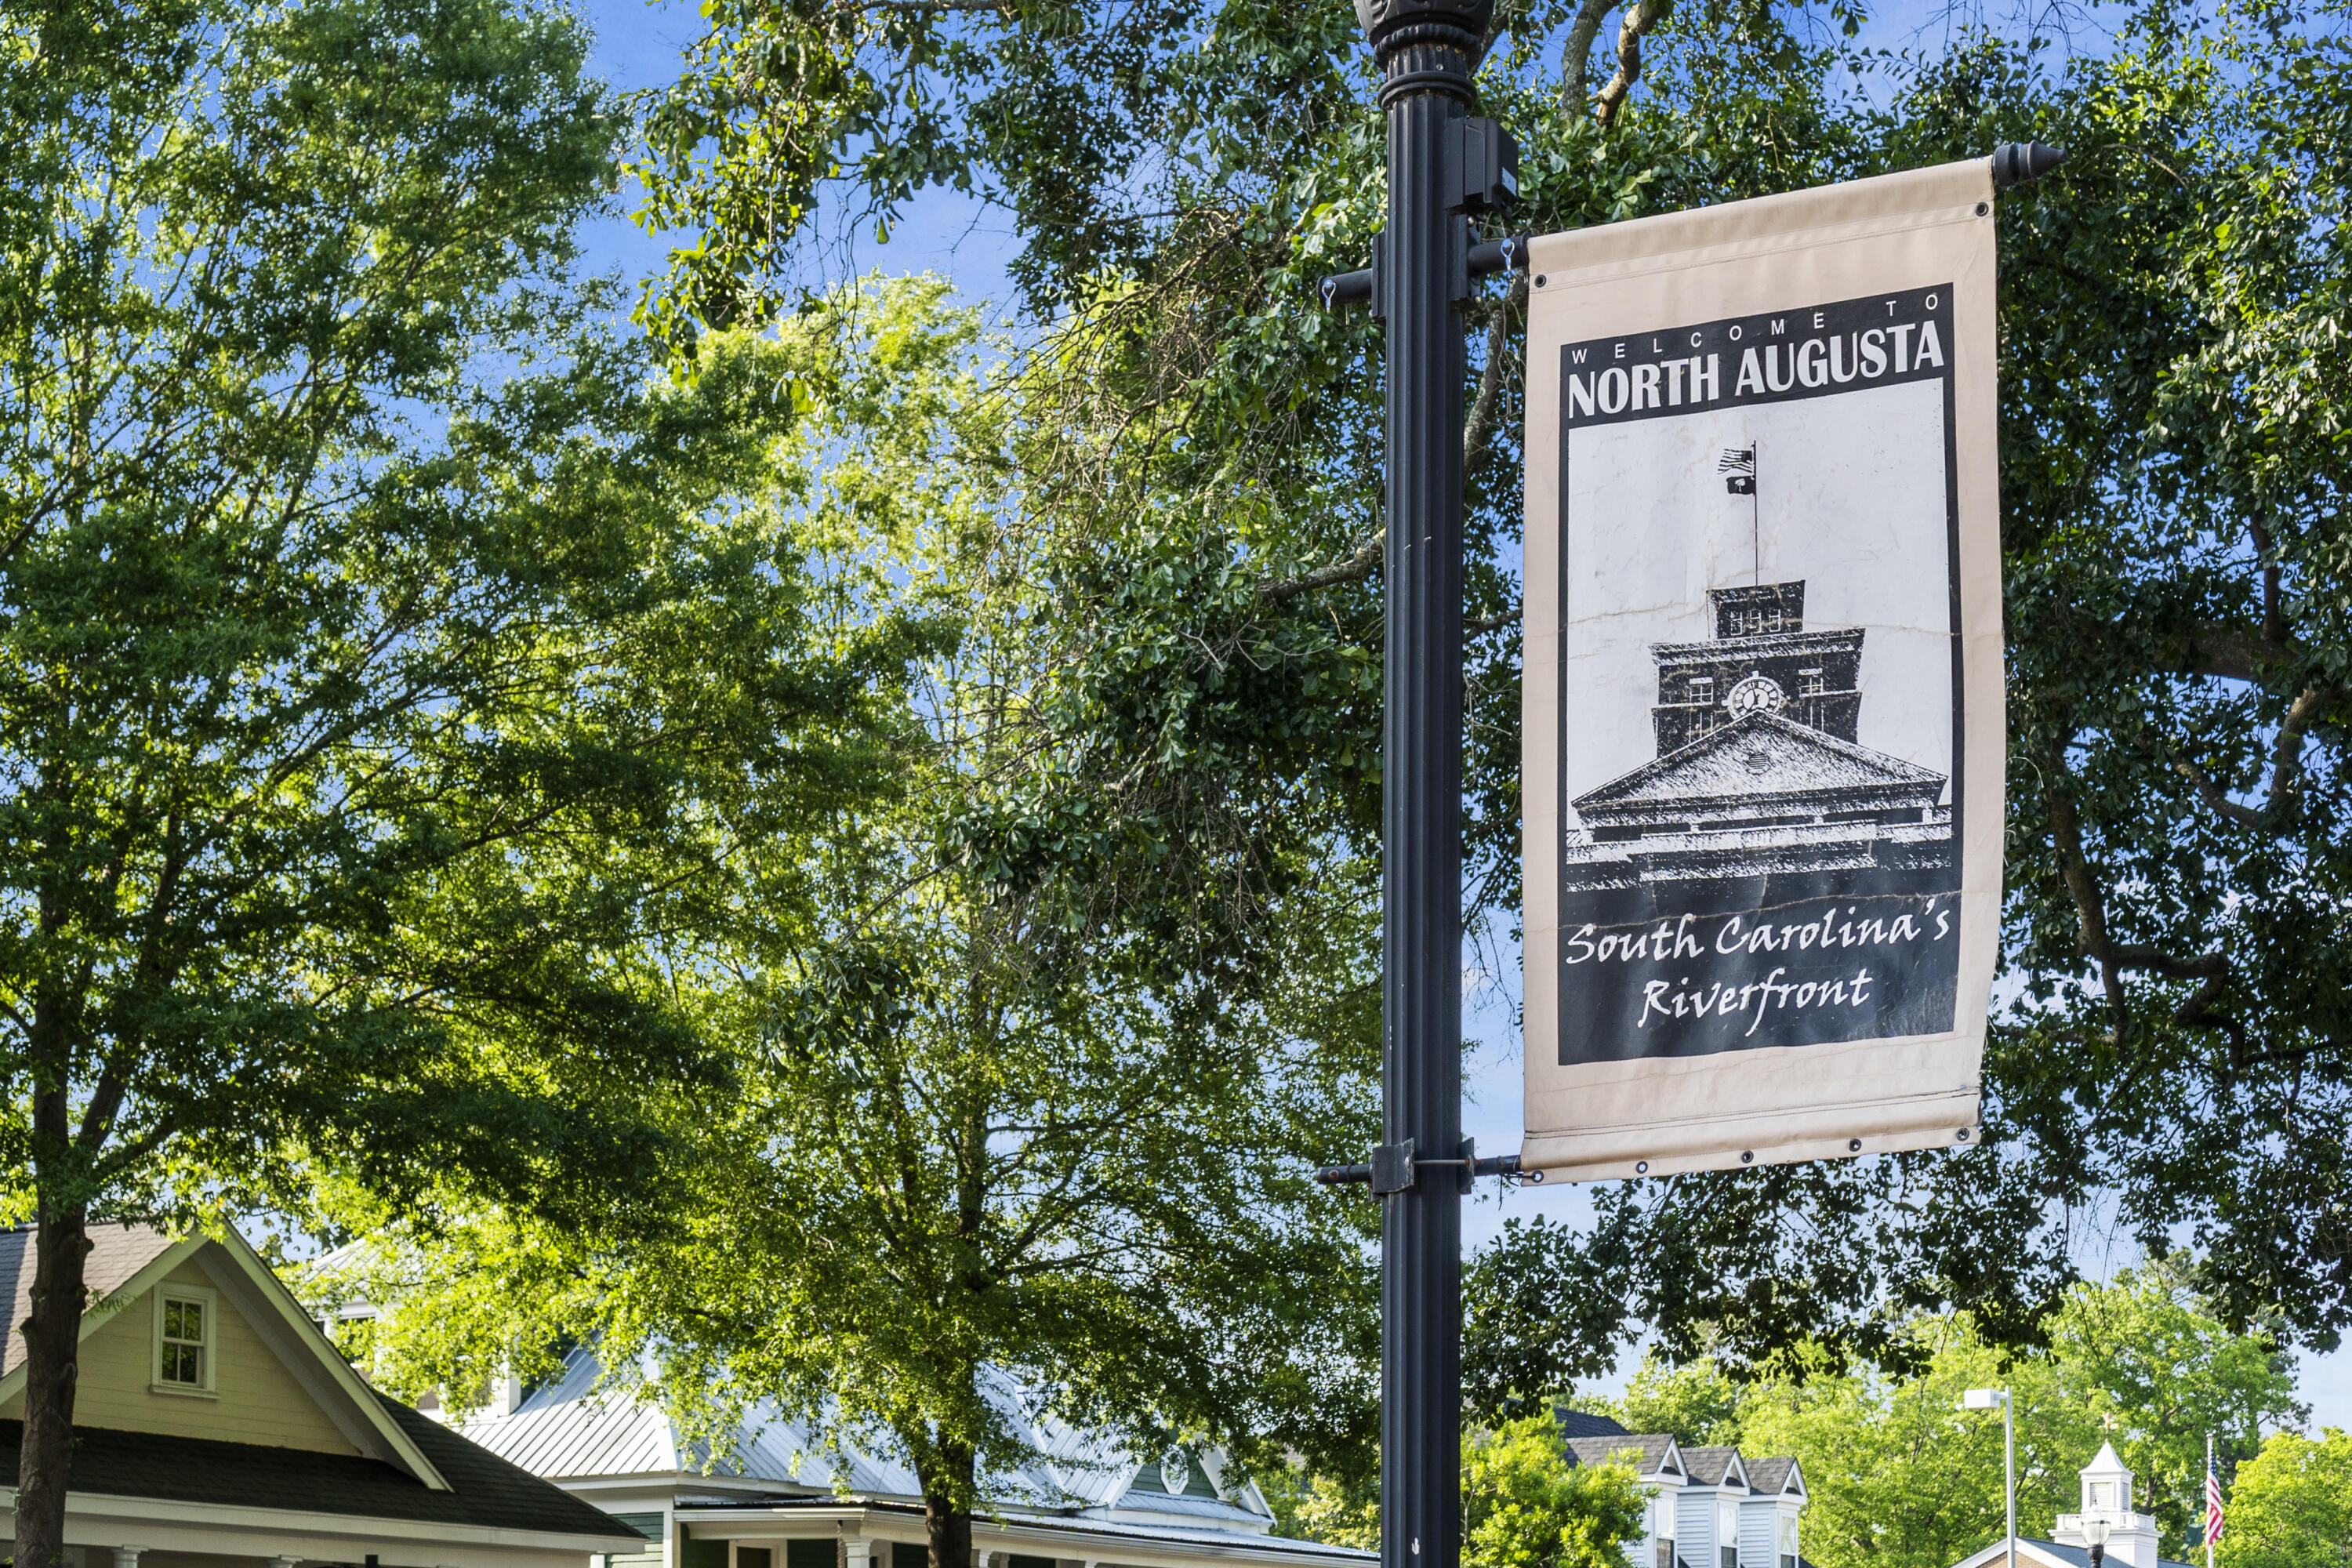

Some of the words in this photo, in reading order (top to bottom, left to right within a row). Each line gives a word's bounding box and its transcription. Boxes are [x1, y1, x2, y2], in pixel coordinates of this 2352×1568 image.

[1571, 312, 1825, 364] WELCOME
[1885, 294, 1940, 316] TO
[1568, 353, 1719, 419] NORTH
[1734, 320, 1945, 397] AUGUSTA
[1566, 913, 1704, 964] South
[1715, 898, 1951, 955] Carolina's
[1637, 967, 1873, 1036] Riverfront
